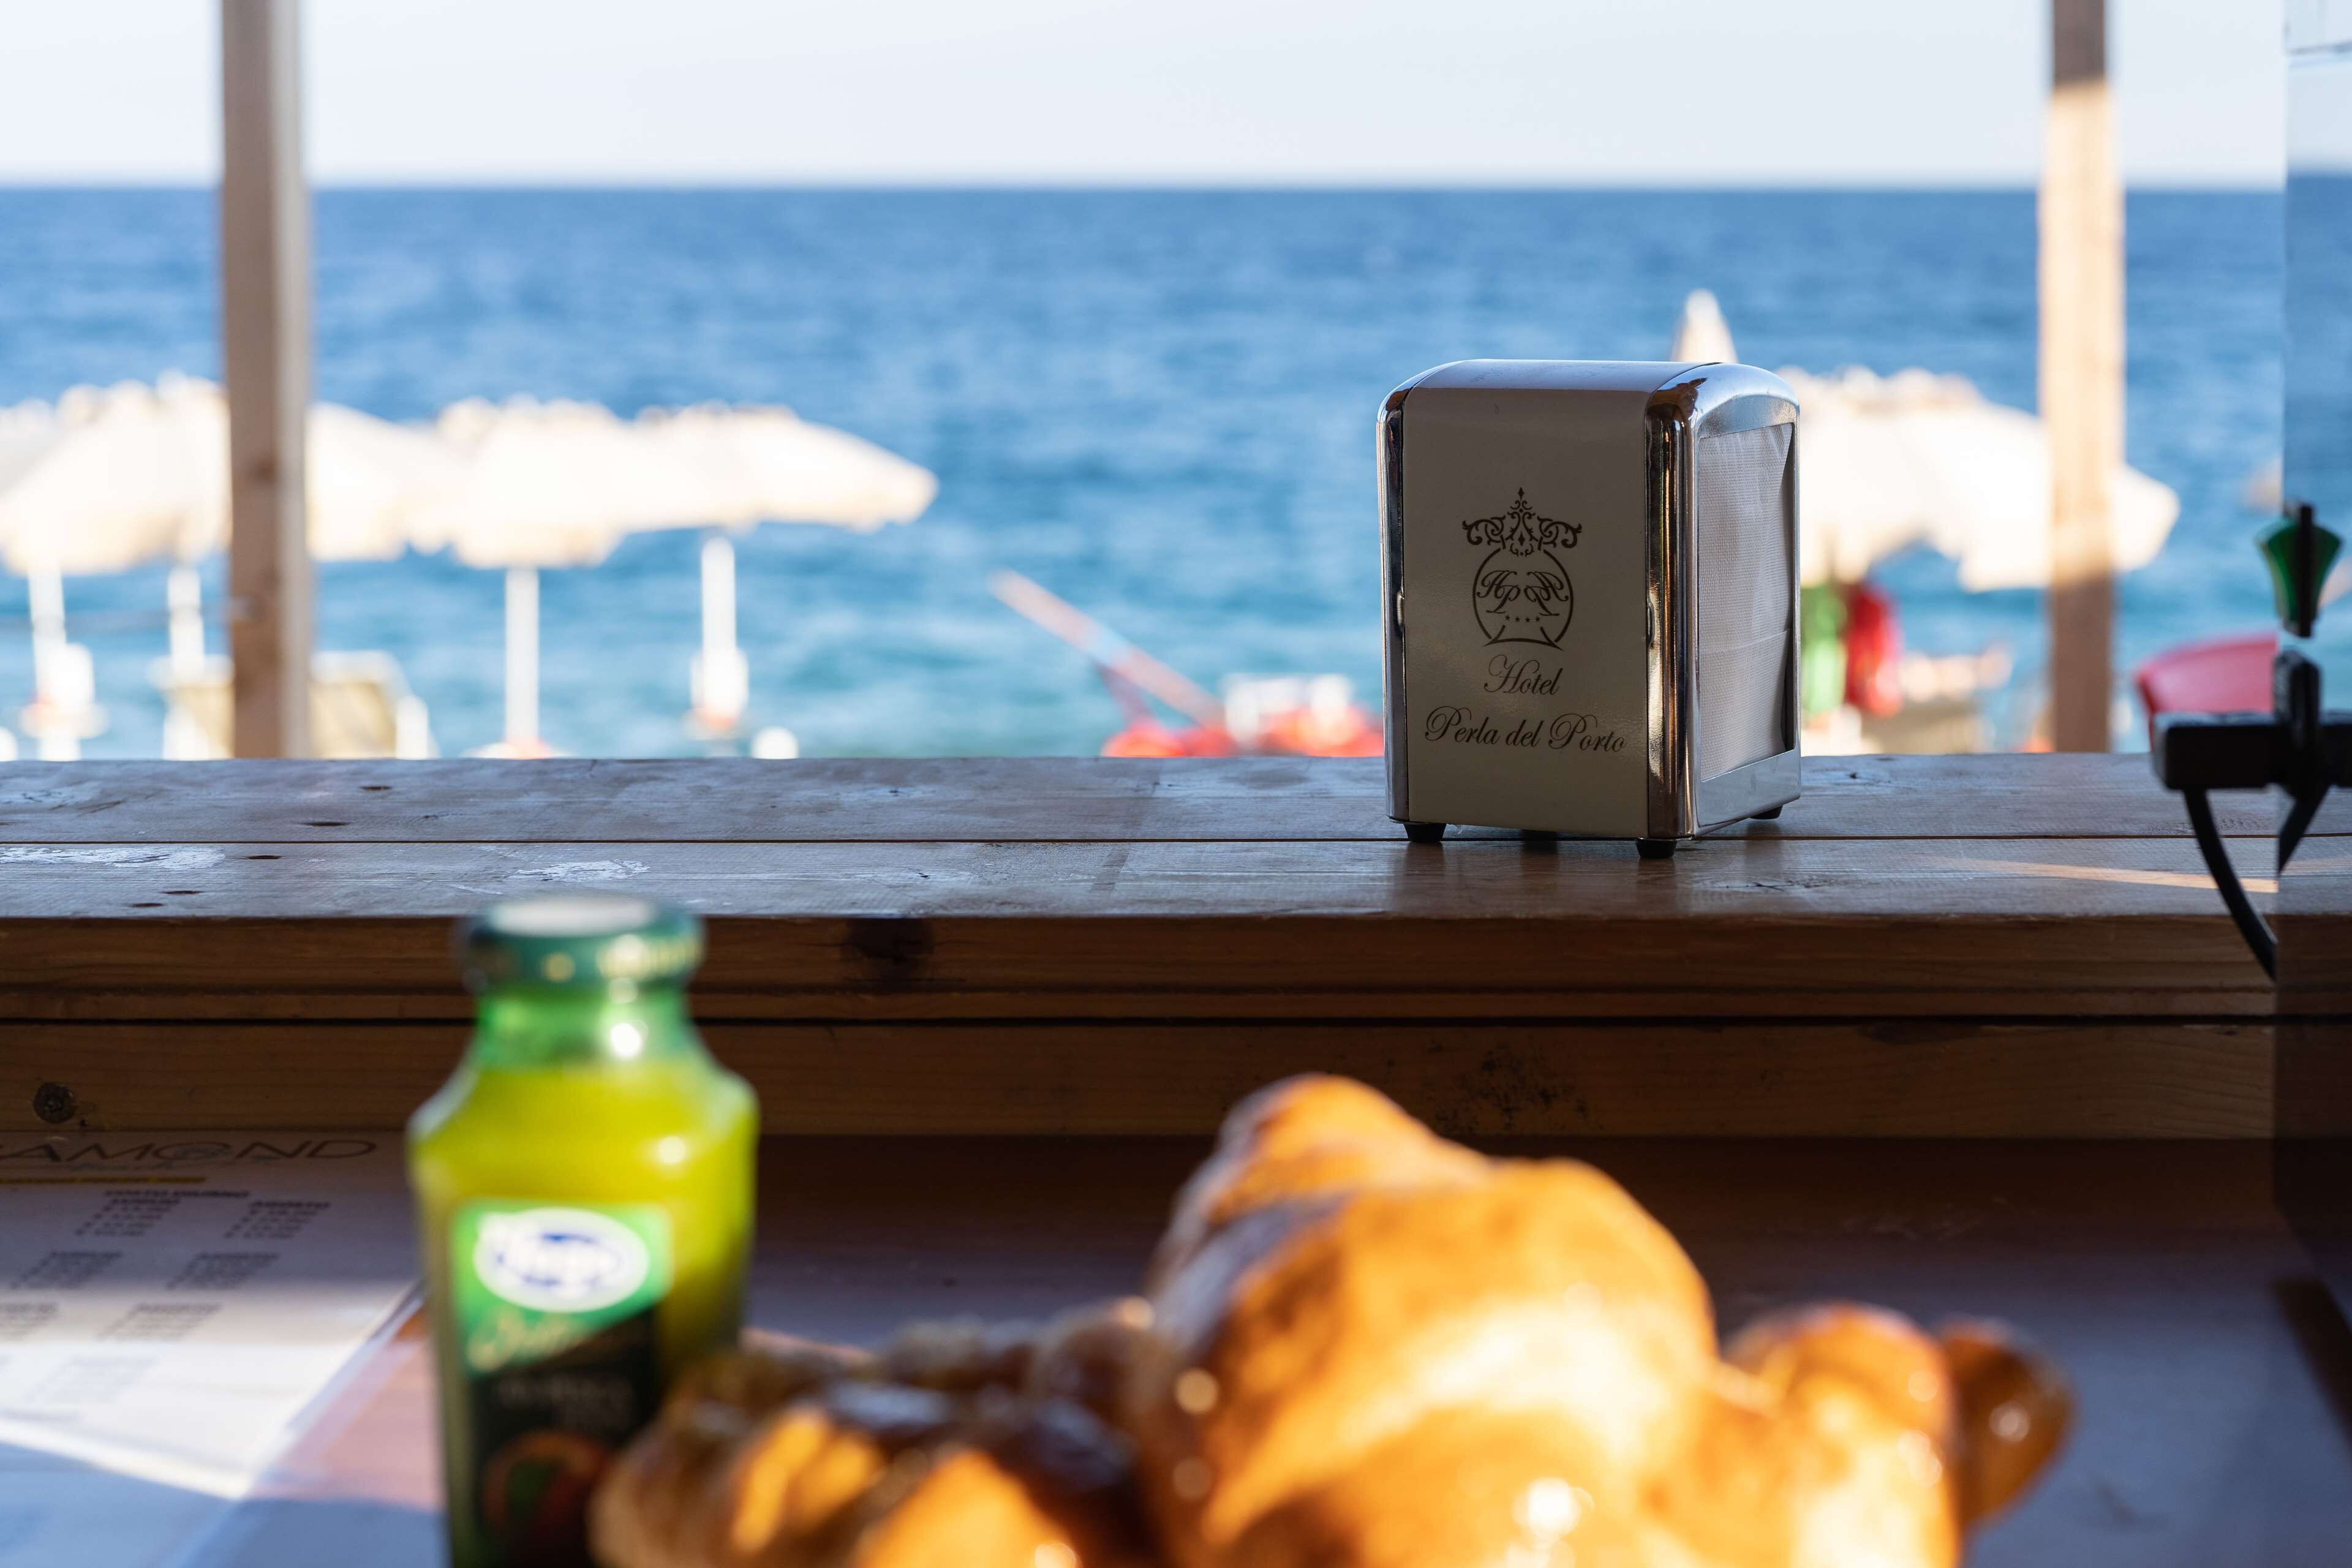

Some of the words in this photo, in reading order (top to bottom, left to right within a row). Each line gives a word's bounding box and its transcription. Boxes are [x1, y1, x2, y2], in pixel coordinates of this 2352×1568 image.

[1483, 654, 1564, 696] Hotel
[1424, 705, 1501, 745] Perla
[1505, 719, 1545, 748] del
[1548, 713, 1626, 753] Porto
[0, 1140, 377, 1162] AMOND
